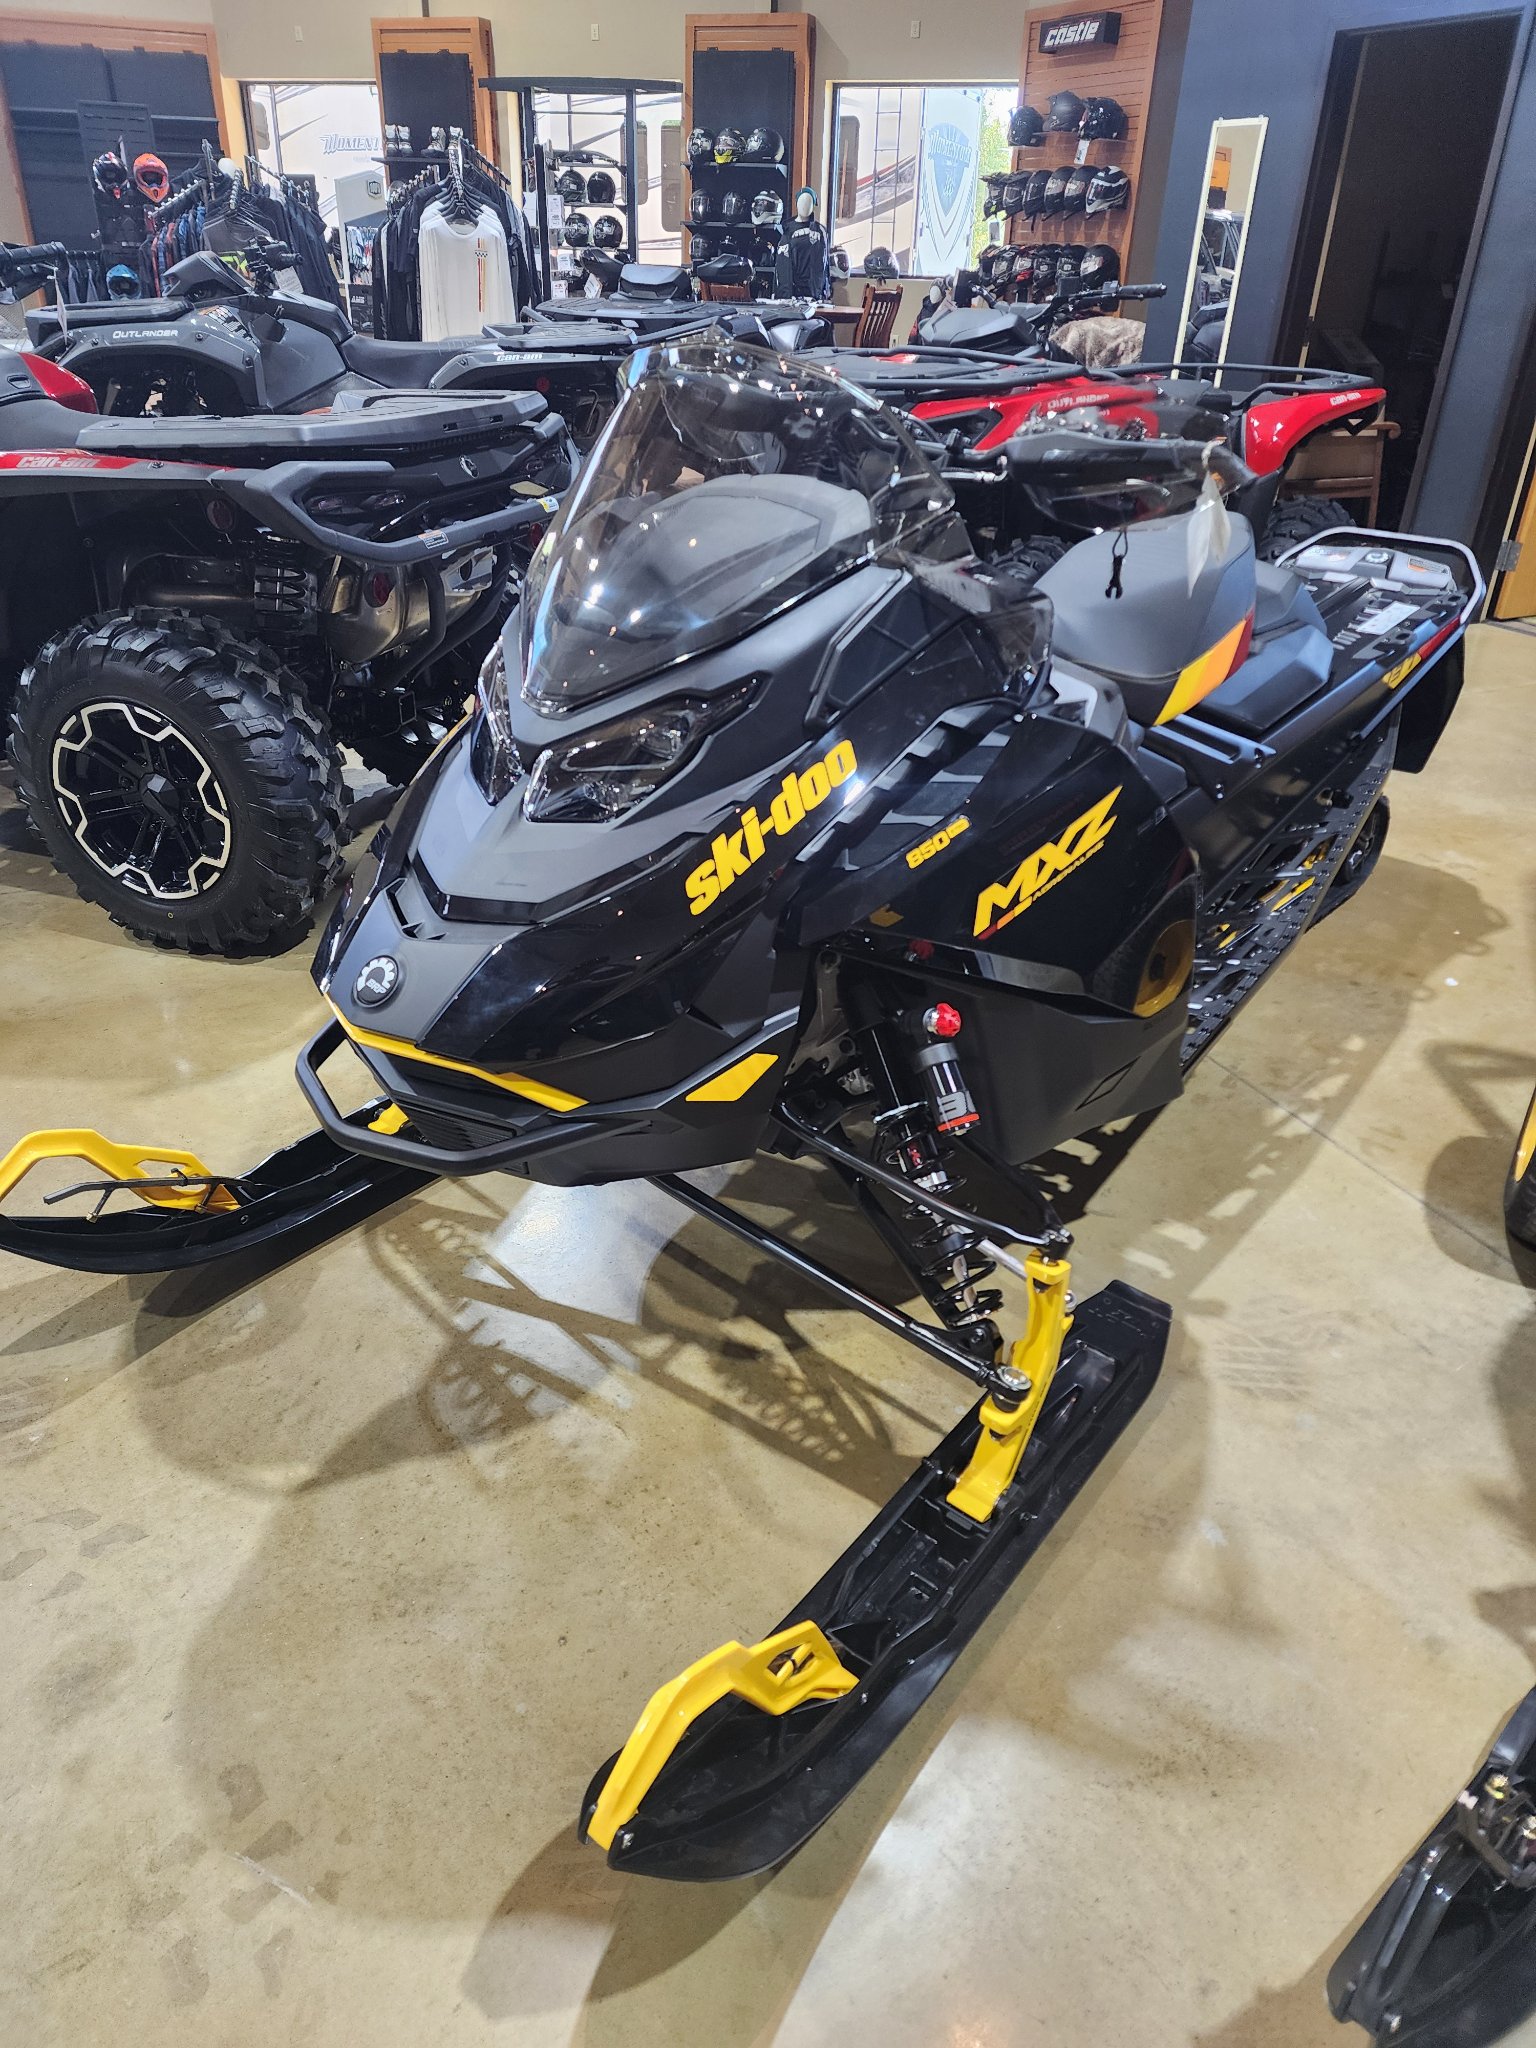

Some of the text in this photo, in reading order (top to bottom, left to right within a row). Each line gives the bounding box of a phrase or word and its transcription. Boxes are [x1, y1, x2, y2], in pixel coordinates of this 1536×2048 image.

[320, 133, 382, 154] MOMENT
[113, 330, 178, 338] OUTLANDER
[16, 456, 100, 468] can-am
[685, 739, 857, 916] ski-doo
[973, 784, 1123, 937] MXZ
[366, 978, 387, 994] BRP
